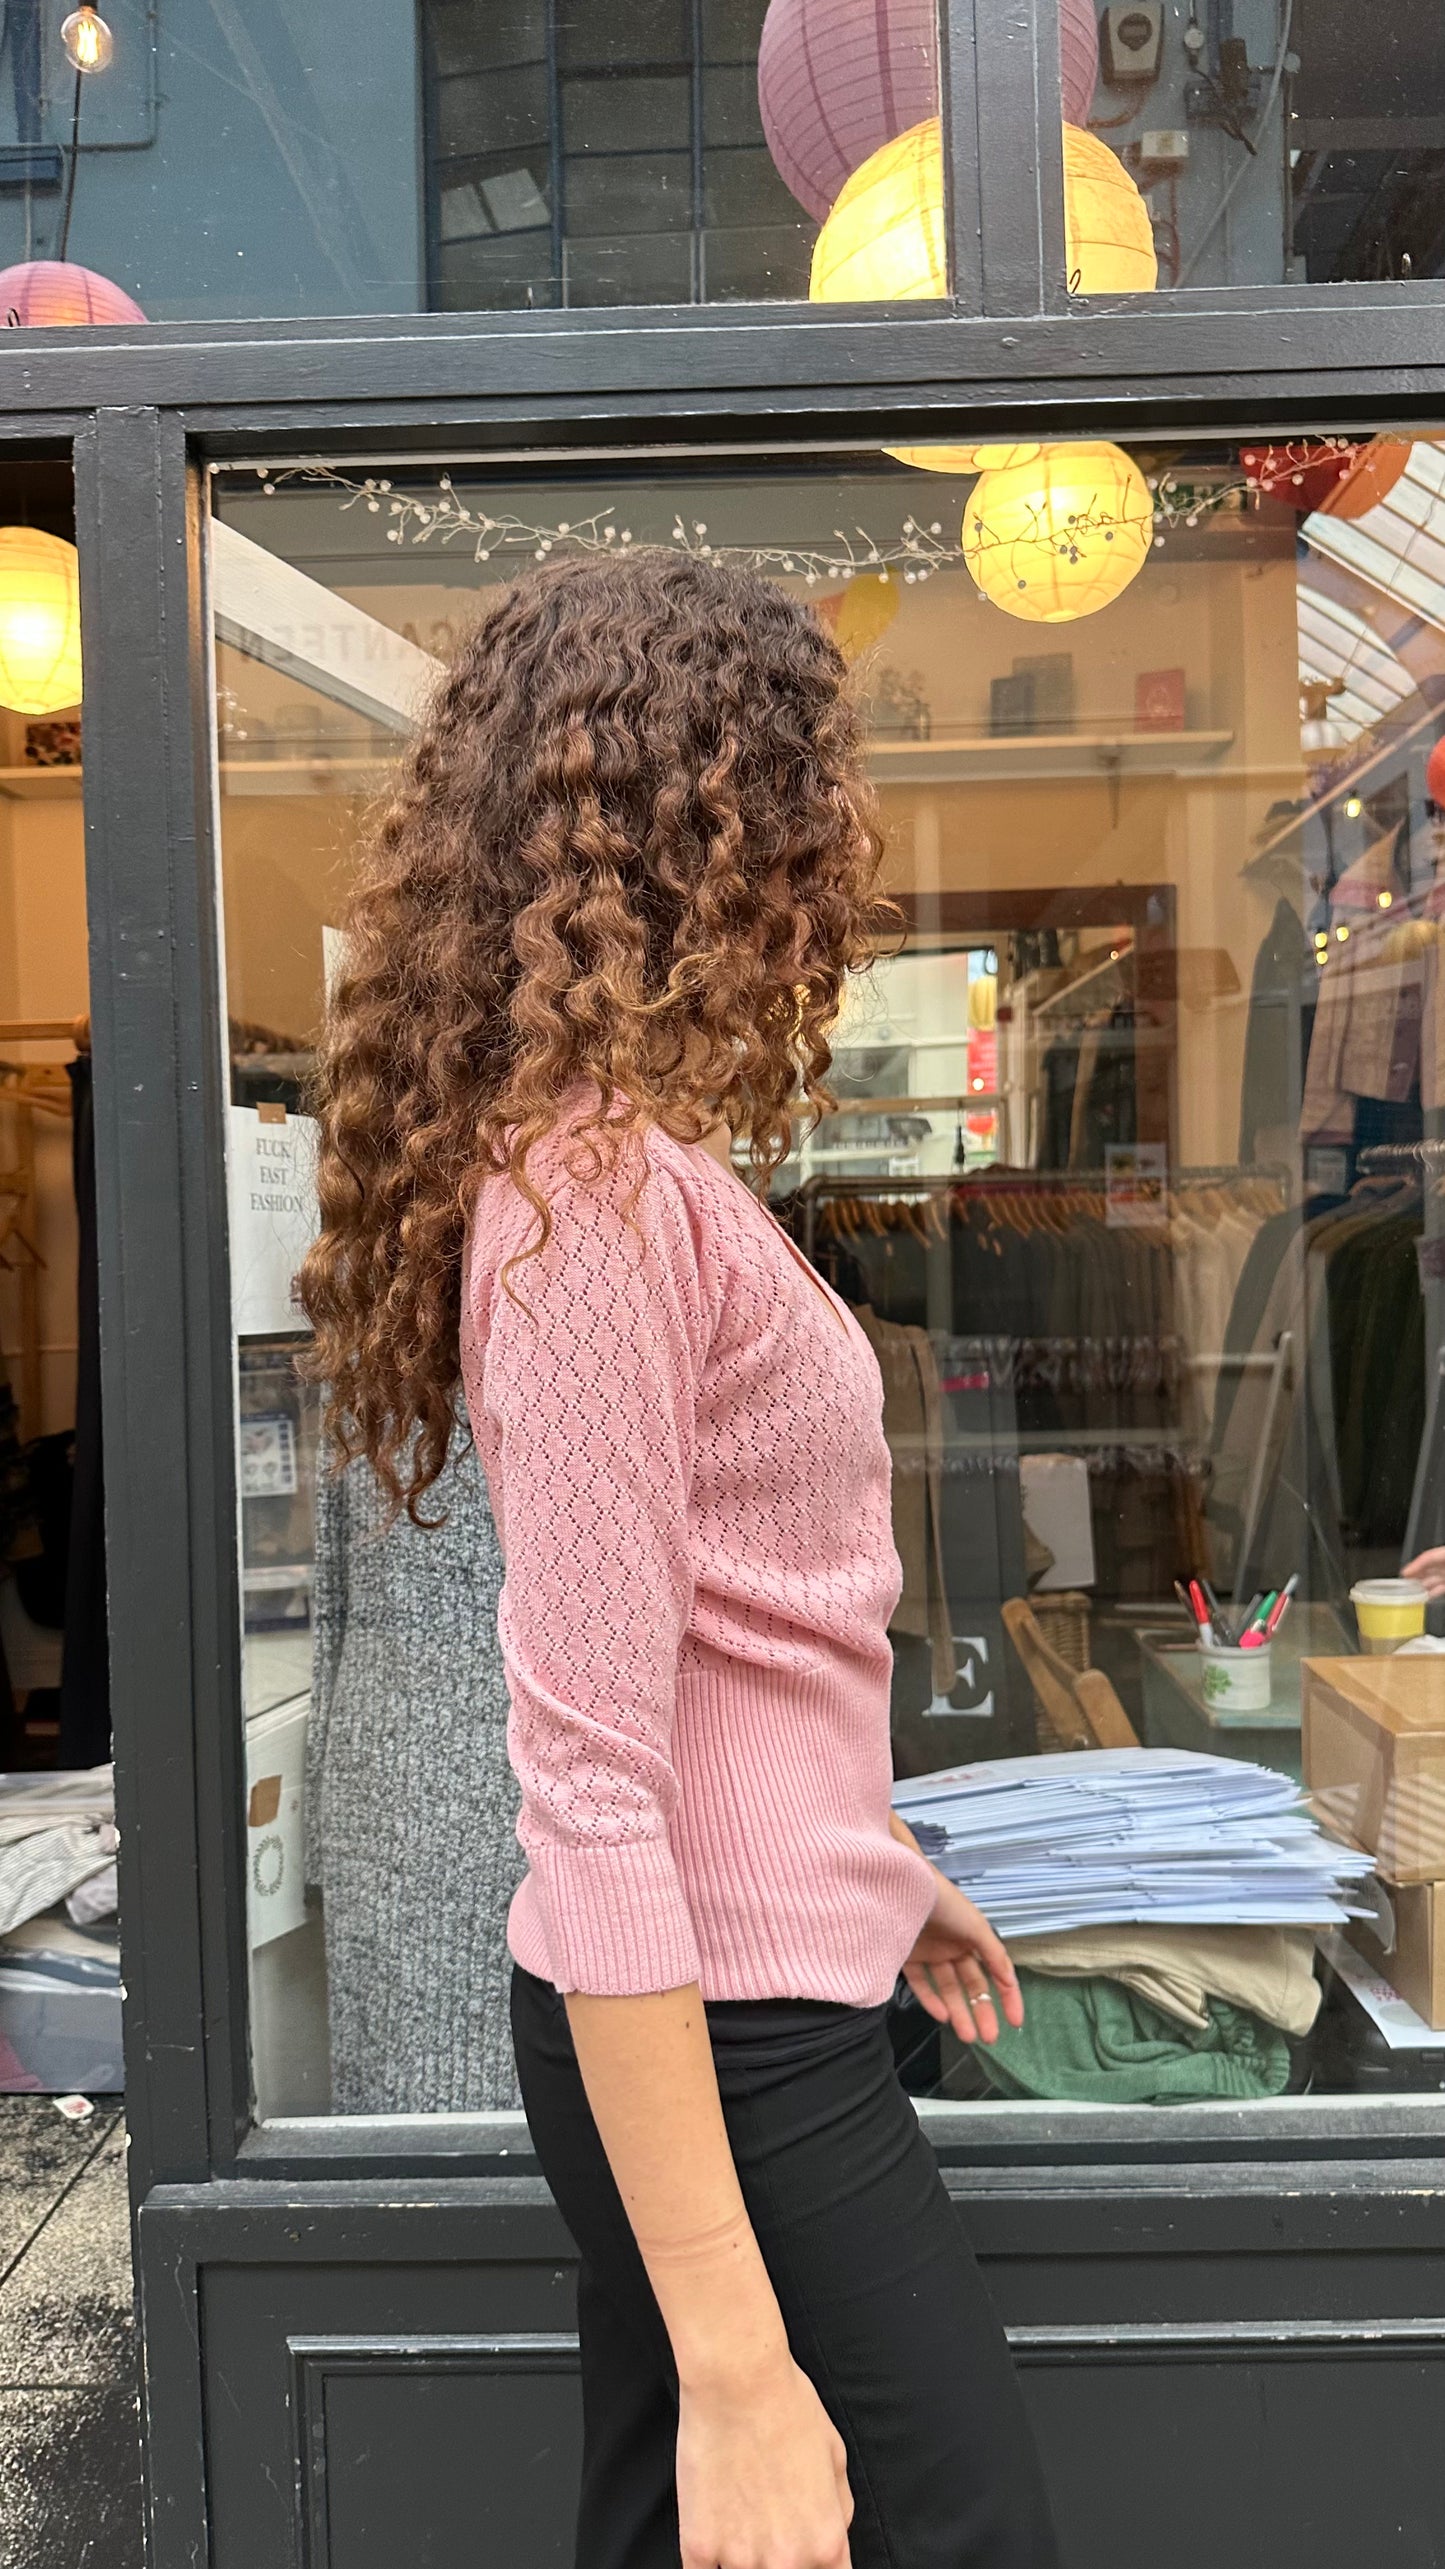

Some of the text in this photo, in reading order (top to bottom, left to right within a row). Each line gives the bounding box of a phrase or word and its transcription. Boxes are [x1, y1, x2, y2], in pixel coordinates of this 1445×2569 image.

[256, 1138, 291, 1158] FUCK
[260, 1166, 288, 1185] FAST
[250, 1192, 304, 1213] FASHION
[922, 1636, 994, 1717] E
